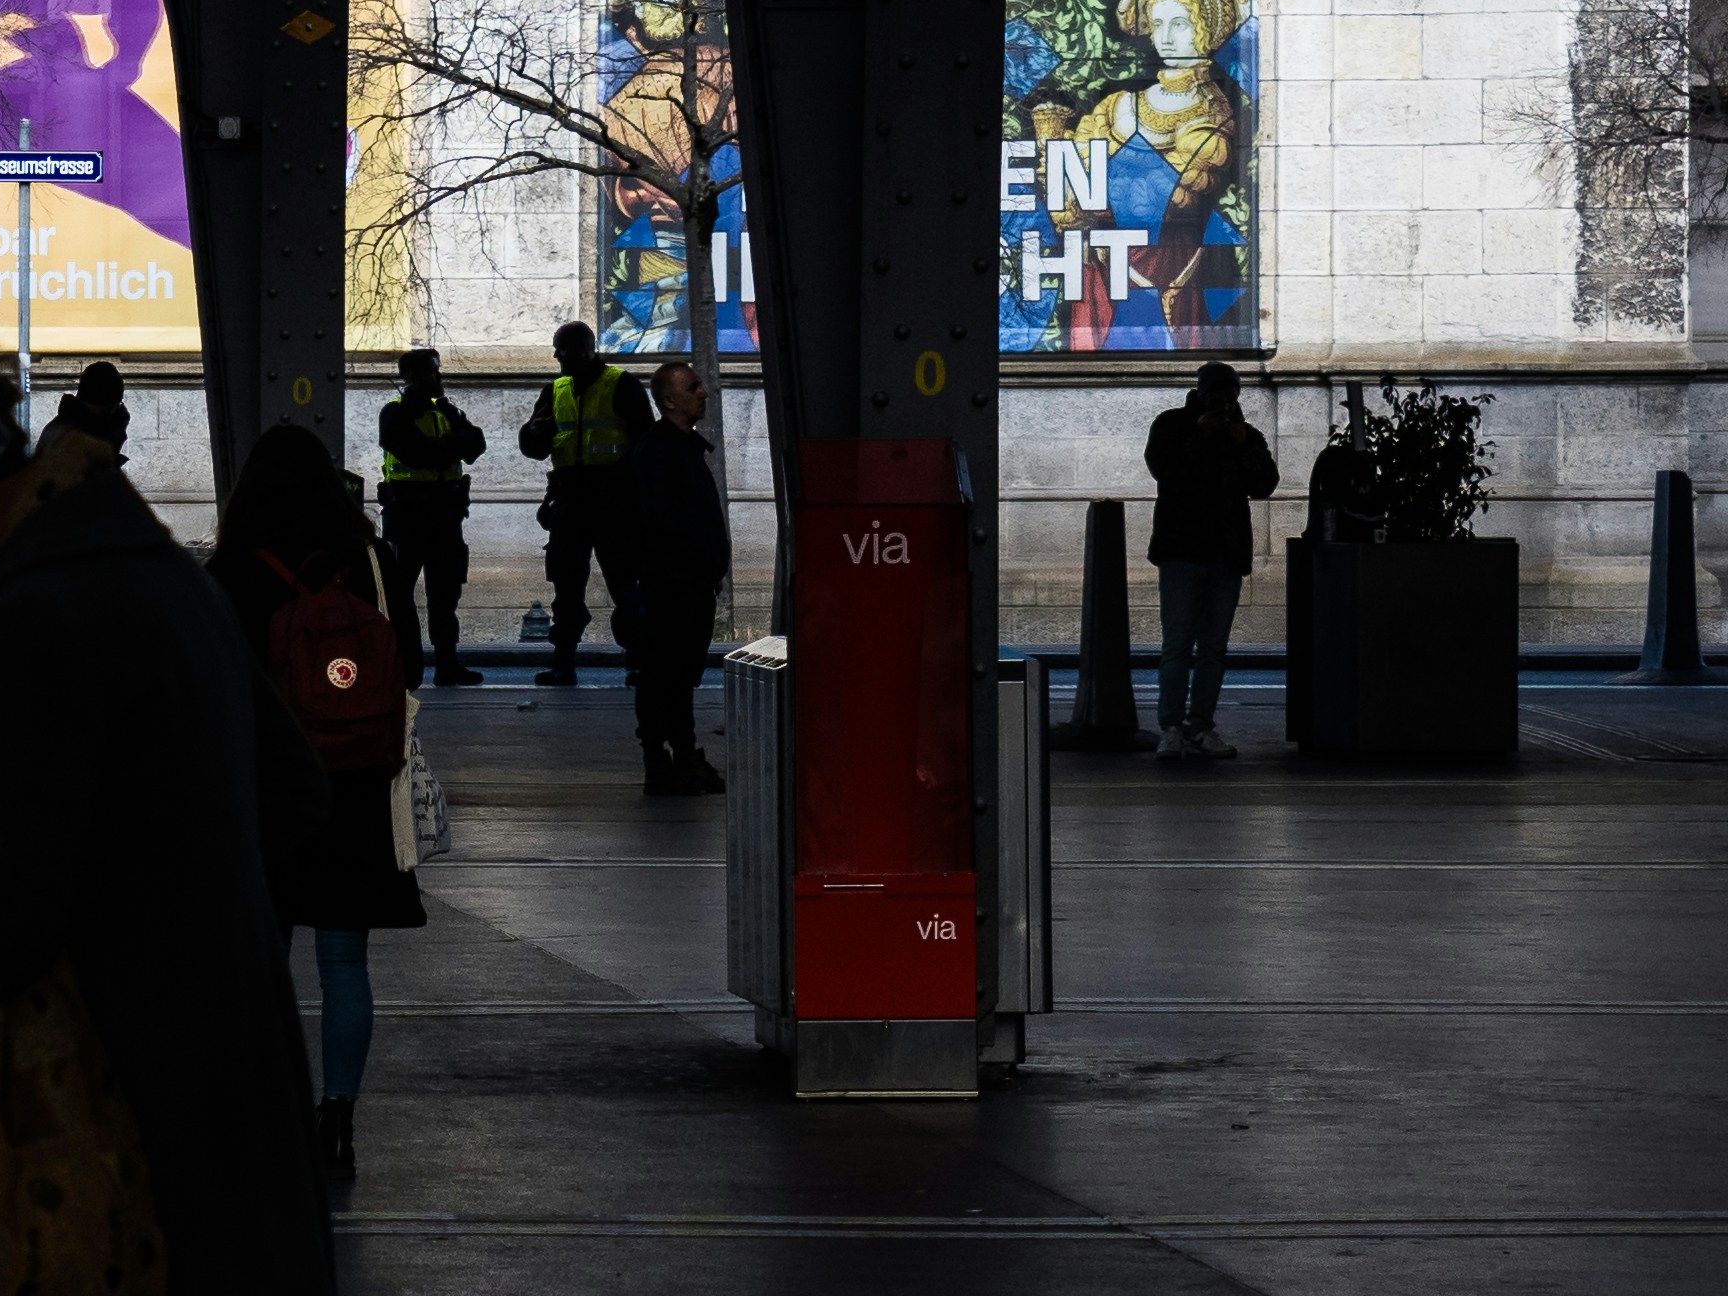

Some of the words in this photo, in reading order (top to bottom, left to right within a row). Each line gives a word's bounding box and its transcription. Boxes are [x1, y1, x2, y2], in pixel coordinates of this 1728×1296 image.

[915, 350, 945, 396] 0
[842, 519, 911, 566] via
[916, 911, 958, 942] via
